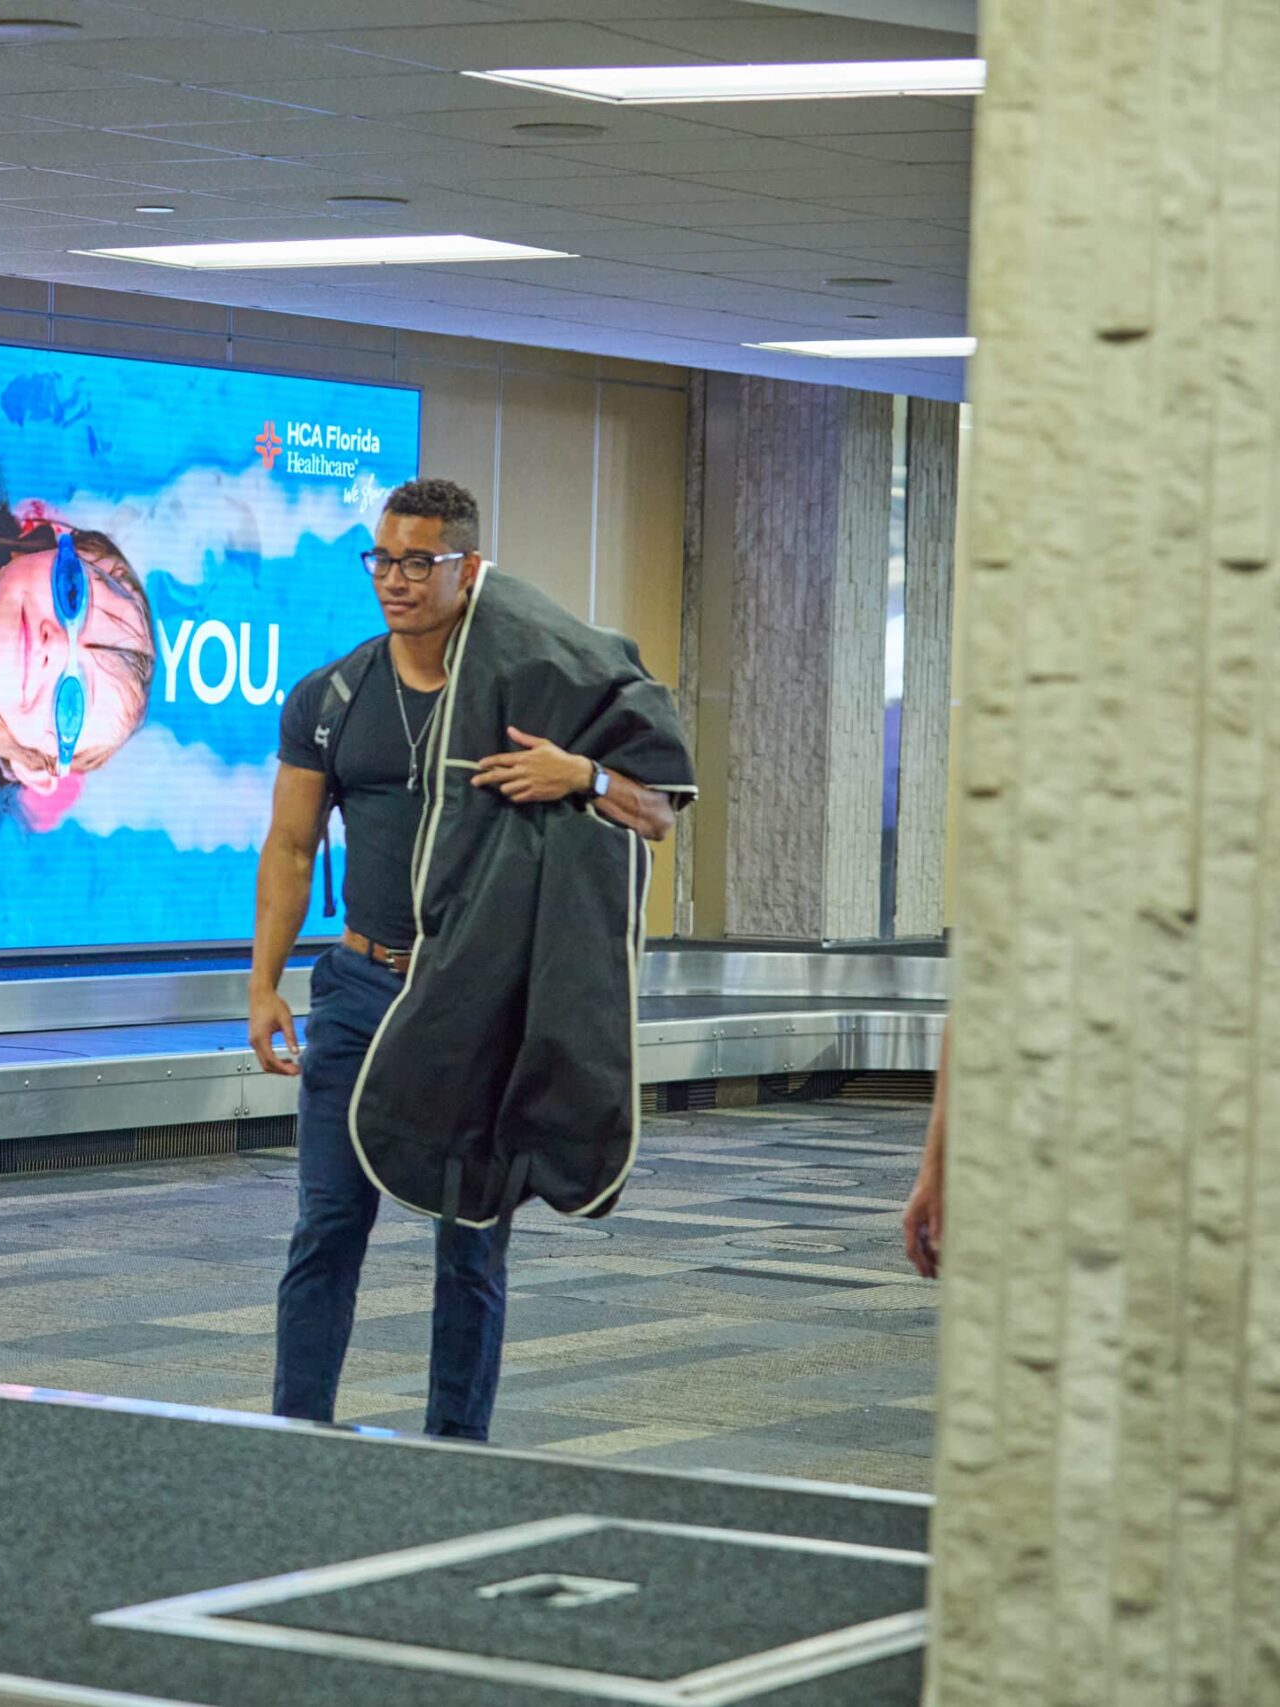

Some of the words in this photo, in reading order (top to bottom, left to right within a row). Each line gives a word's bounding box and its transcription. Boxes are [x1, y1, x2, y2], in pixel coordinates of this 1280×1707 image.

[287, 421, 323, 448] HCA
[326, 425, 380, 453] Florida
[286, 451, 356, 478] Healthcare
[343, 482, 359, 503] we
[157, 619, 285, 706] YOU.
